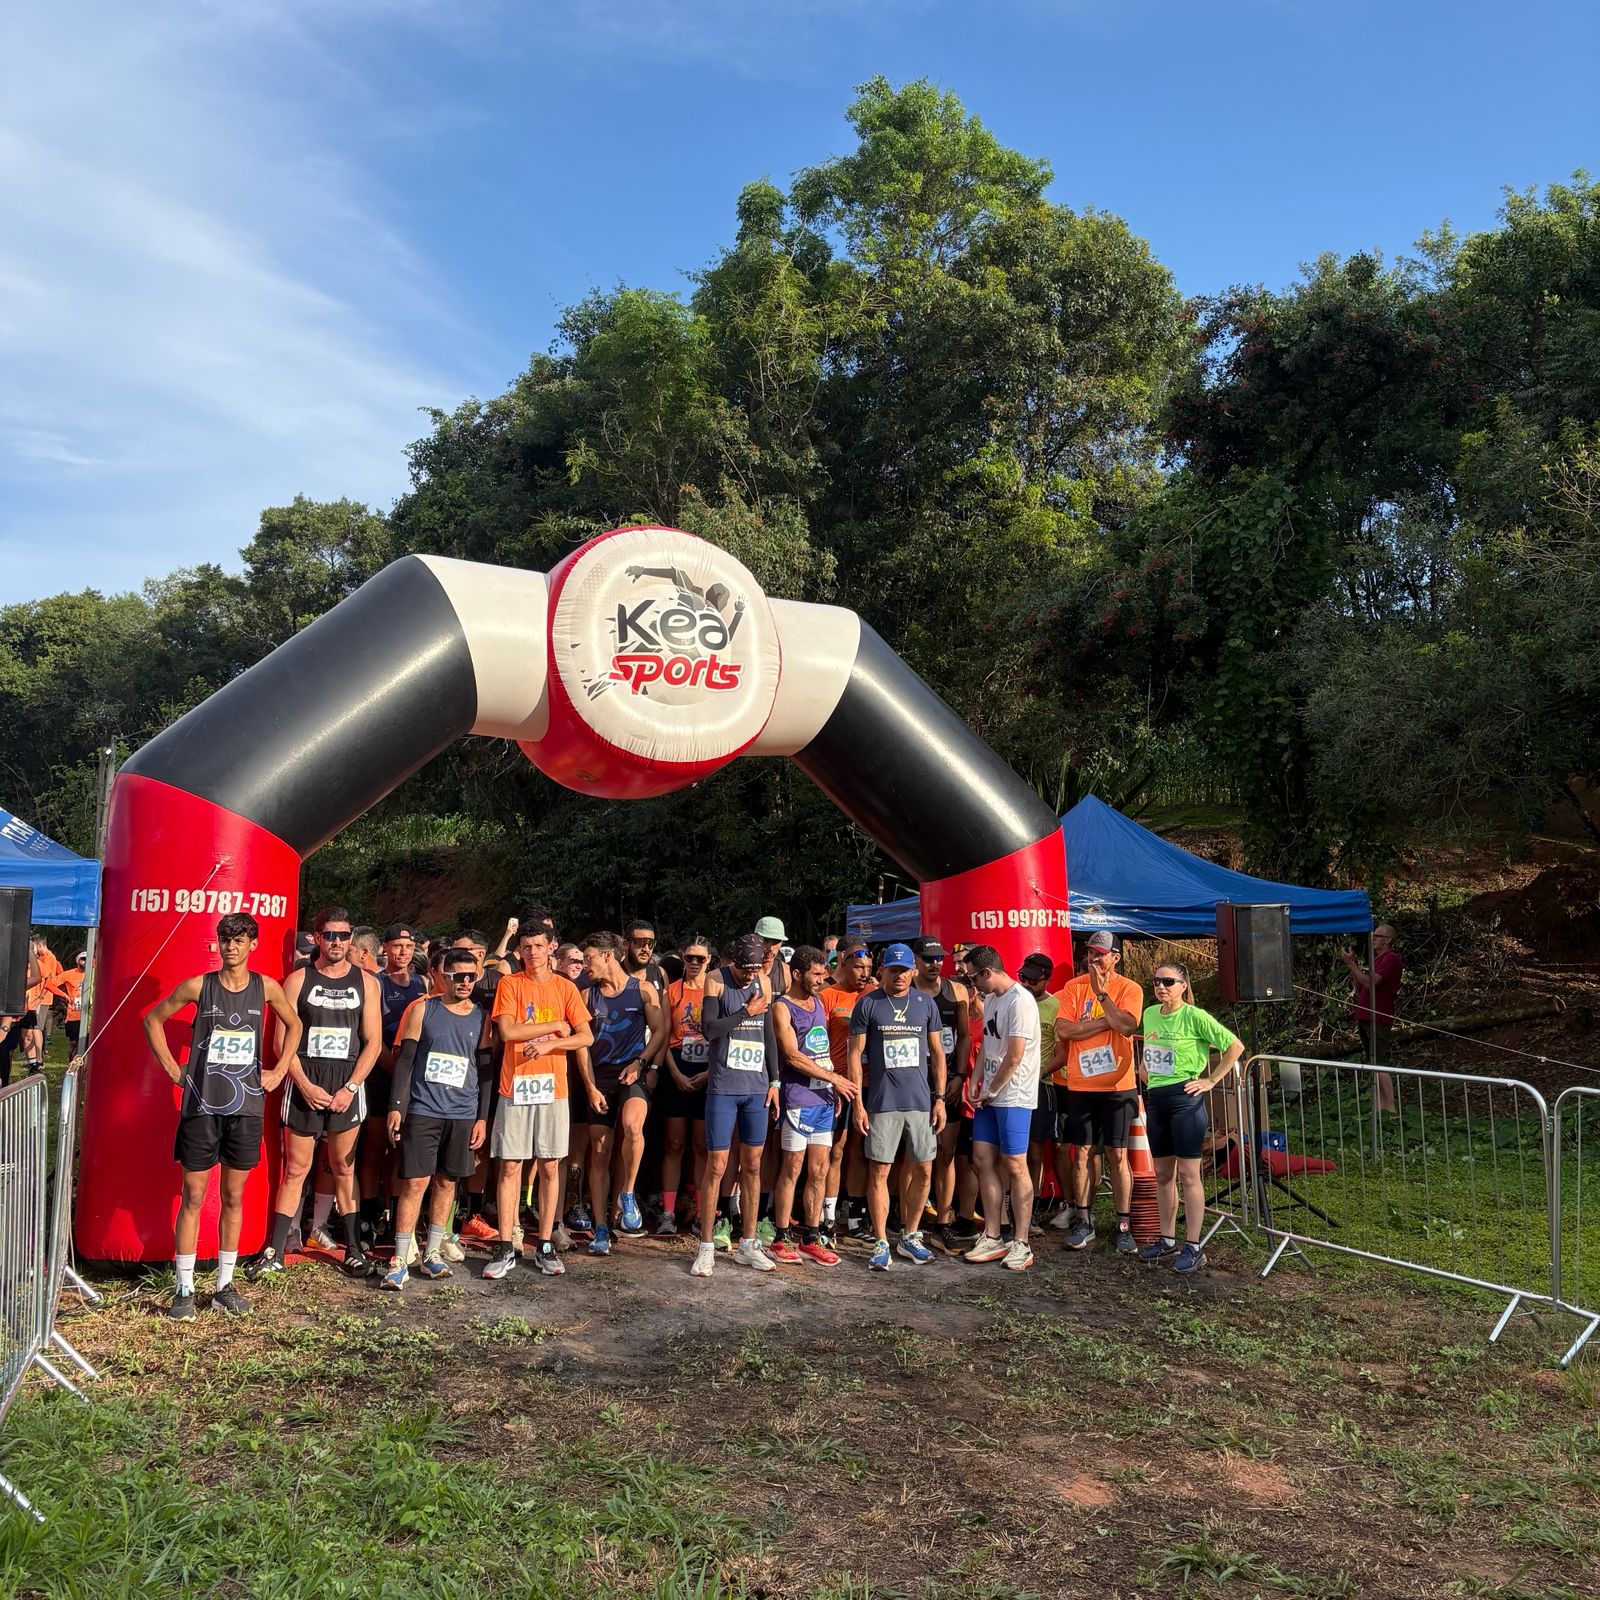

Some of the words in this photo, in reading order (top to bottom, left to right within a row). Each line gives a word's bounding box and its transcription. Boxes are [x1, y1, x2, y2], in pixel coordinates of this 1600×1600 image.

[617, 599, 730, 651] Kea
[130, 888, 170, 912] (15)
[175, 889, 288, 918] 99787-7387
[970, 910, 1005, 930] (15)
[210, 1036, 254, 1054] 454
[310, 1033, 349, 1051] 123
[885, 1043, 918, 1059] 041
[728, 1046, 763, 1064] 408
[1080, 1049, 1114, 1069] 541
[1144, 1048, 1174, 1066] 634
[515, 1078, 555, 1095] 404
